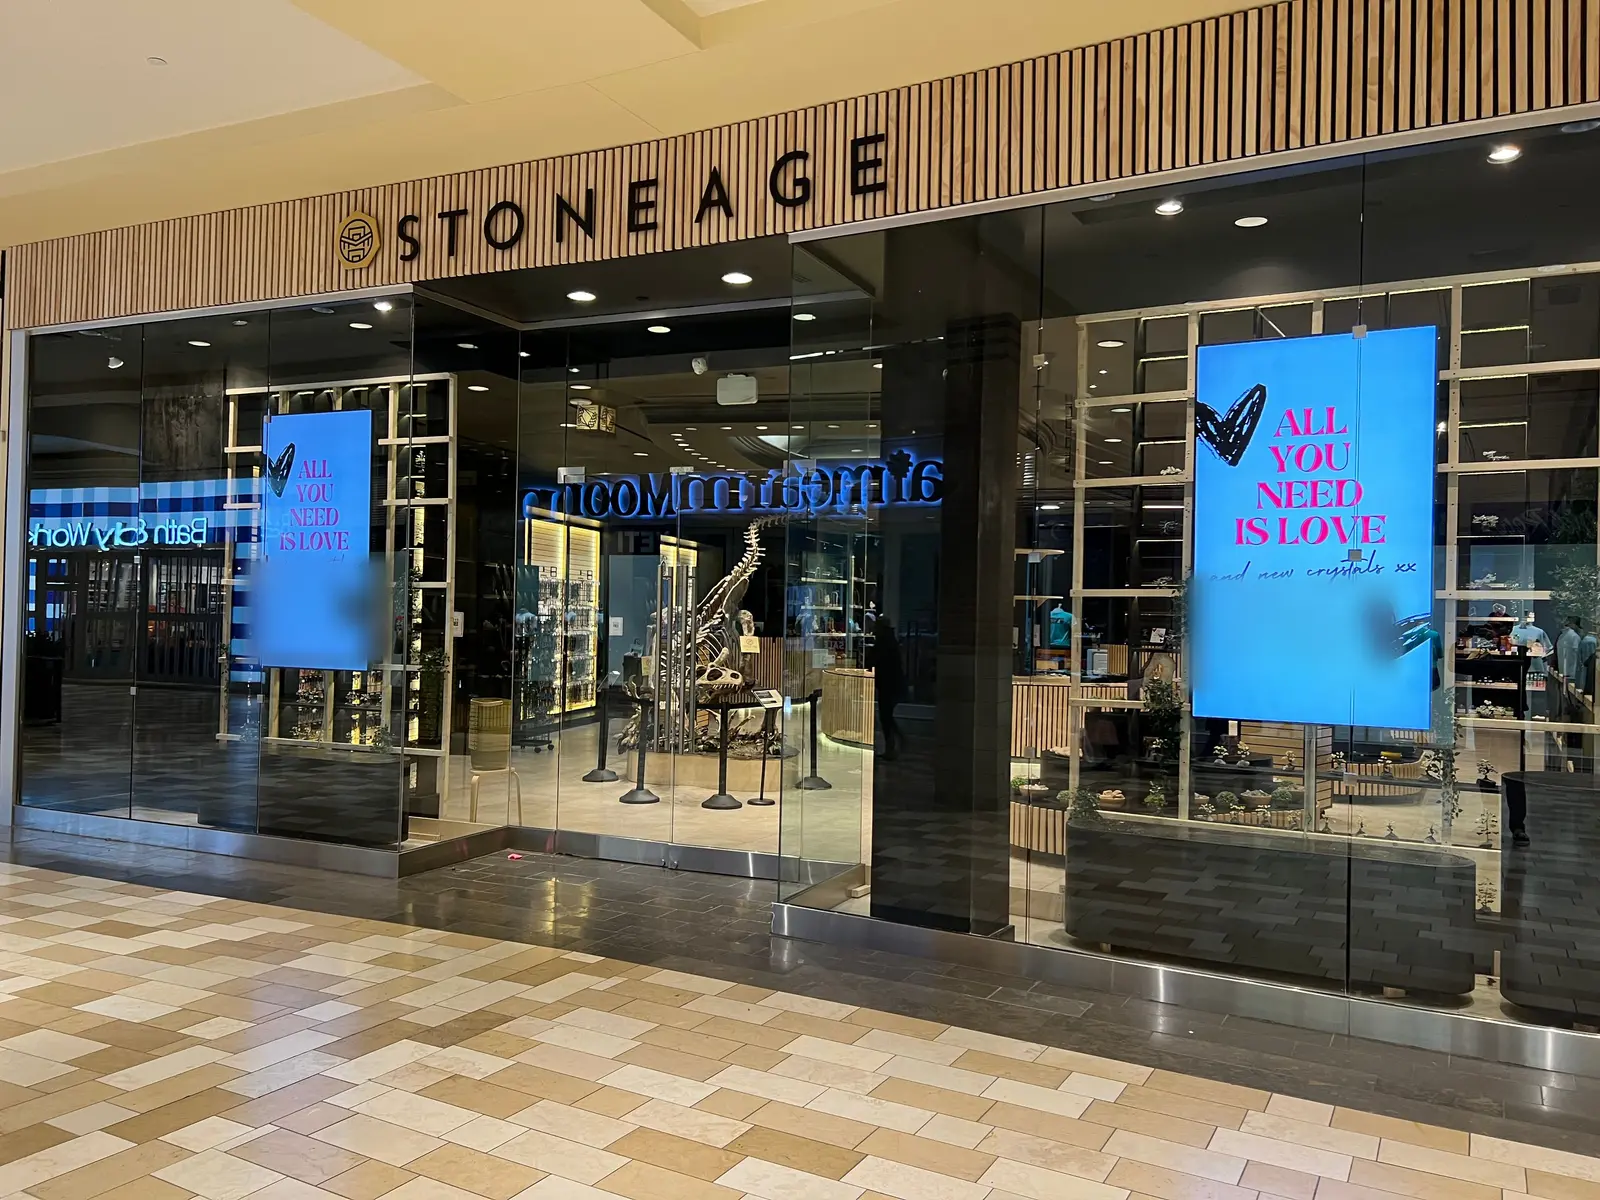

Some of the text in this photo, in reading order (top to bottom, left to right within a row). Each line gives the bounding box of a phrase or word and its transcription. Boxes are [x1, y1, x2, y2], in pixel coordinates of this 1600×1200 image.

[1273, 405, 1350, 438] ALL
[298, 459, 333, 479] ALL
[1268, 441, 1352, 474] YOU
[295, 483, 335, 503] YOU
[1256, 478, 1364, 511] NEED
[289, 507, 339, 527] NEED
[1234, 514, 1389, 547] IS LOVE
[279, 531, 350, 551] IS LOVE
[1210, 549, 1417, 584] and new crystals xx
